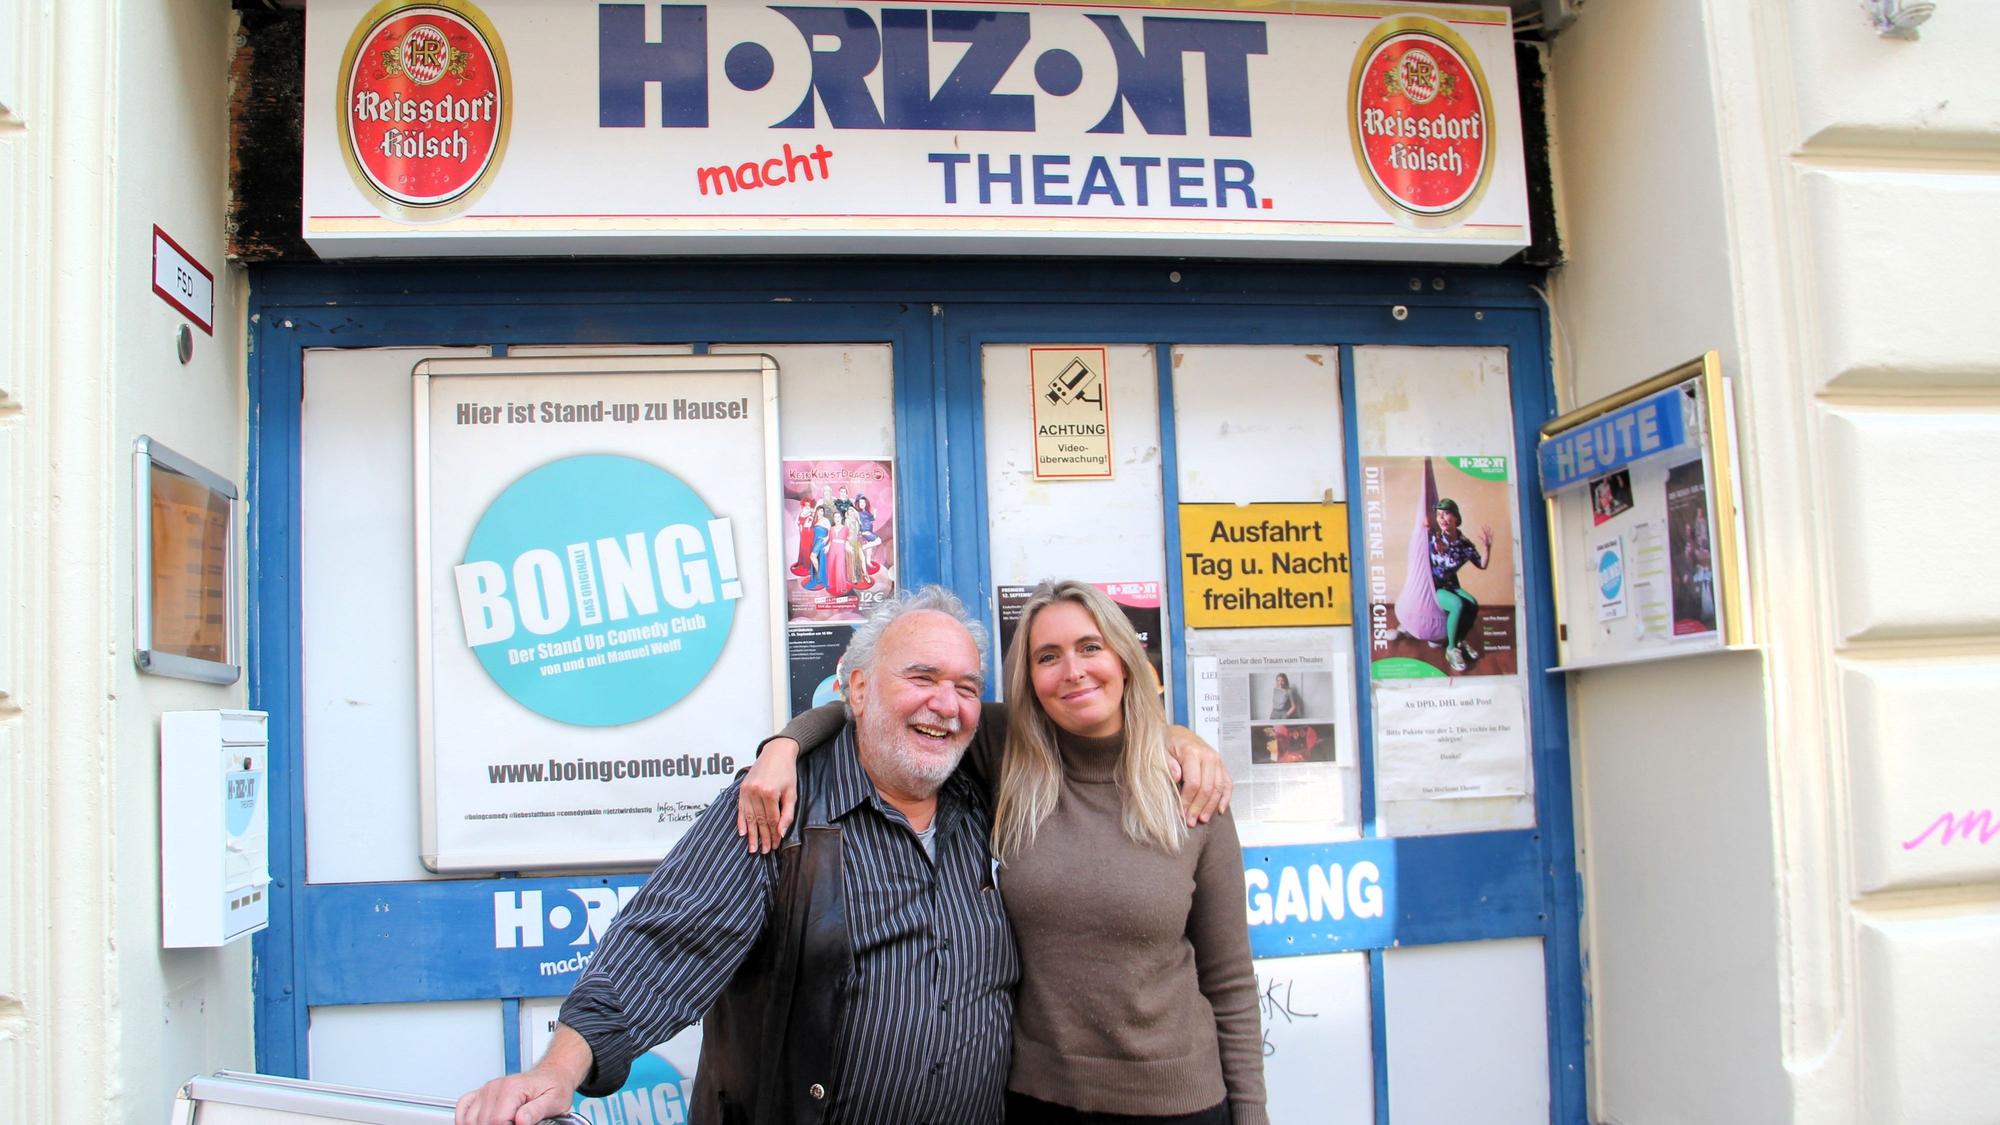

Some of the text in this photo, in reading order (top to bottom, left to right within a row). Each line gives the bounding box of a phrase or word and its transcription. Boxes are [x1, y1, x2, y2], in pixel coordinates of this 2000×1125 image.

[600, 4, 1268, 137] HORIZONT
[354, 90, 496, 122] Reissdorf
[1363, 107, 1480, 140] Reissdorf
[380, 128, 468, 163] Kölsch
[1388, 142, 1462, 177] Kölsch
[697, 143, 834, 196] macht
[928, 153, 1273, 210] THEATER.
[177, 266, 194, 298] FSD
[456, 398, 748, 425] Hier ist Stand-up zu Hause!
[1039, 424, 1106, 436] ACHTUNG
[1555, 404, 1661, 481] HEUTE
[1040, 453, 1108, 466] überwachung!
[1058, 443, 1089, 453] Video-
[1210, 520, 1323, 543] Ausfahrt
[1186, 551, 1348, 581] Tag u. Nacht
[1365, 466, 1388, 651] DIE KLEINE EIDECHSE
[454, 517, 745, 648] BOING!
[1203, 586, 1334, 611] freihalten!
[508, 614, 706, 666] Der Stand Up Comedy Club
[540, 662, 561, 676] von
[563, 657, 585, 672] und
[587, 654, 606, 667] mit
[608, 647, 650, 664] Manuel
[1219, 657, 1239, 665] Leben
[488, 753, 735, 784] www.boingcomedy.de
[666, 812, 693, 822] Tickets
[494, 887, 640, 948] HOR
[571, 1078, 694, 1125] OING
